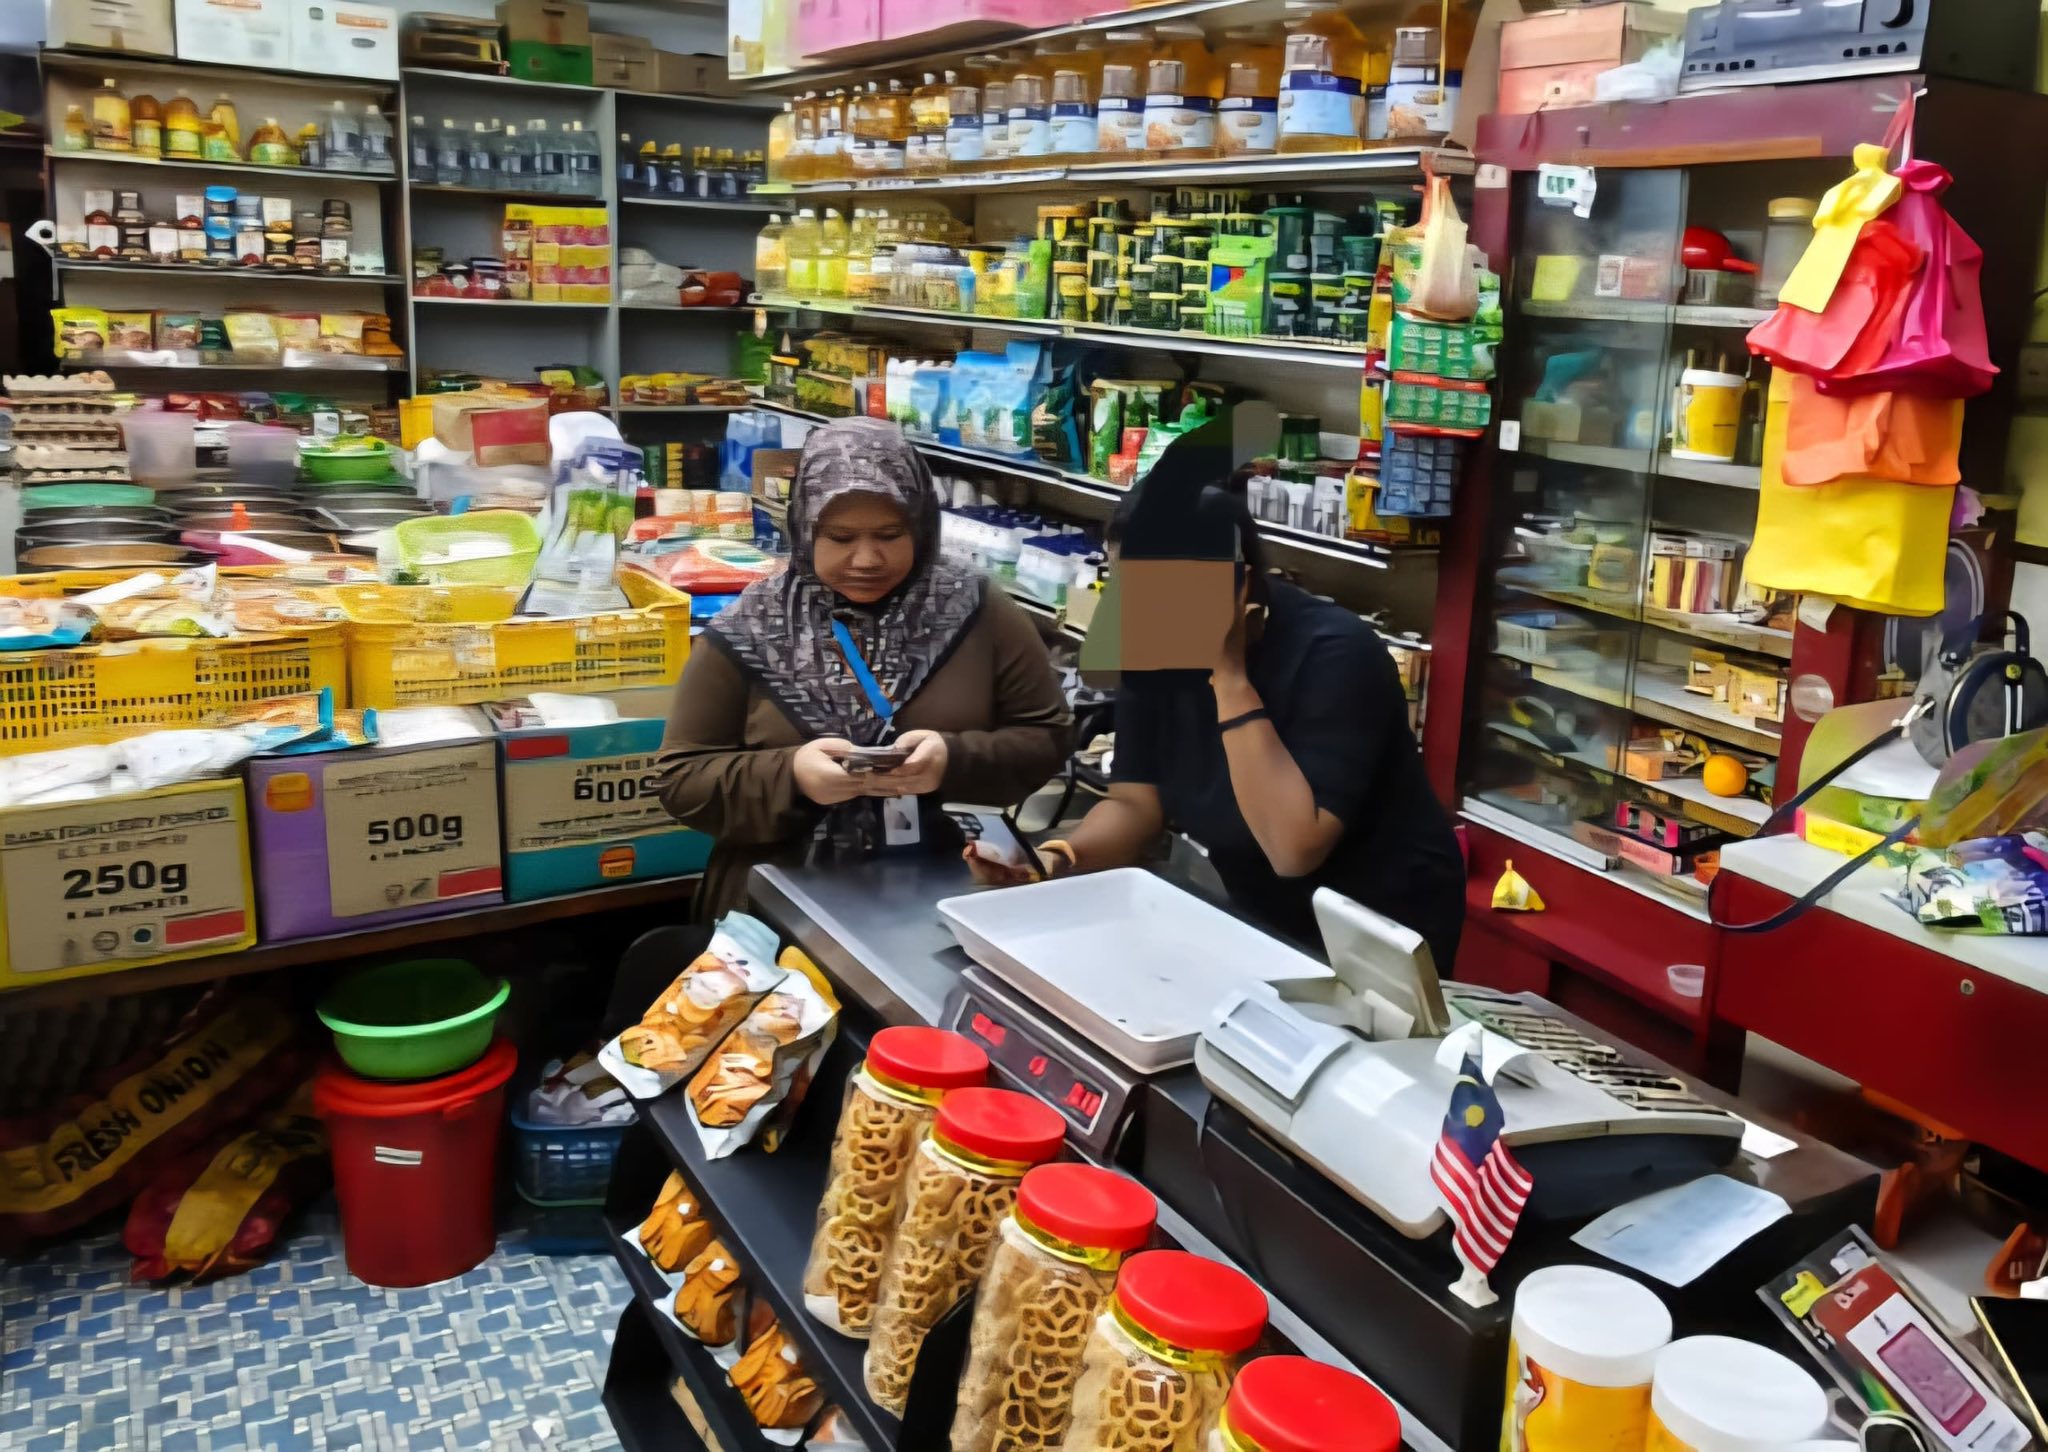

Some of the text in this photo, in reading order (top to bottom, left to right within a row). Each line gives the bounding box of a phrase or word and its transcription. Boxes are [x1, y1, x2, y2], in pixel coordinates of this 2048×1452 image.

[368, 813, 463, 845] 500g
[63, 860, 187, 900] 250g
[138, 1040, 231, 1114] ONION
